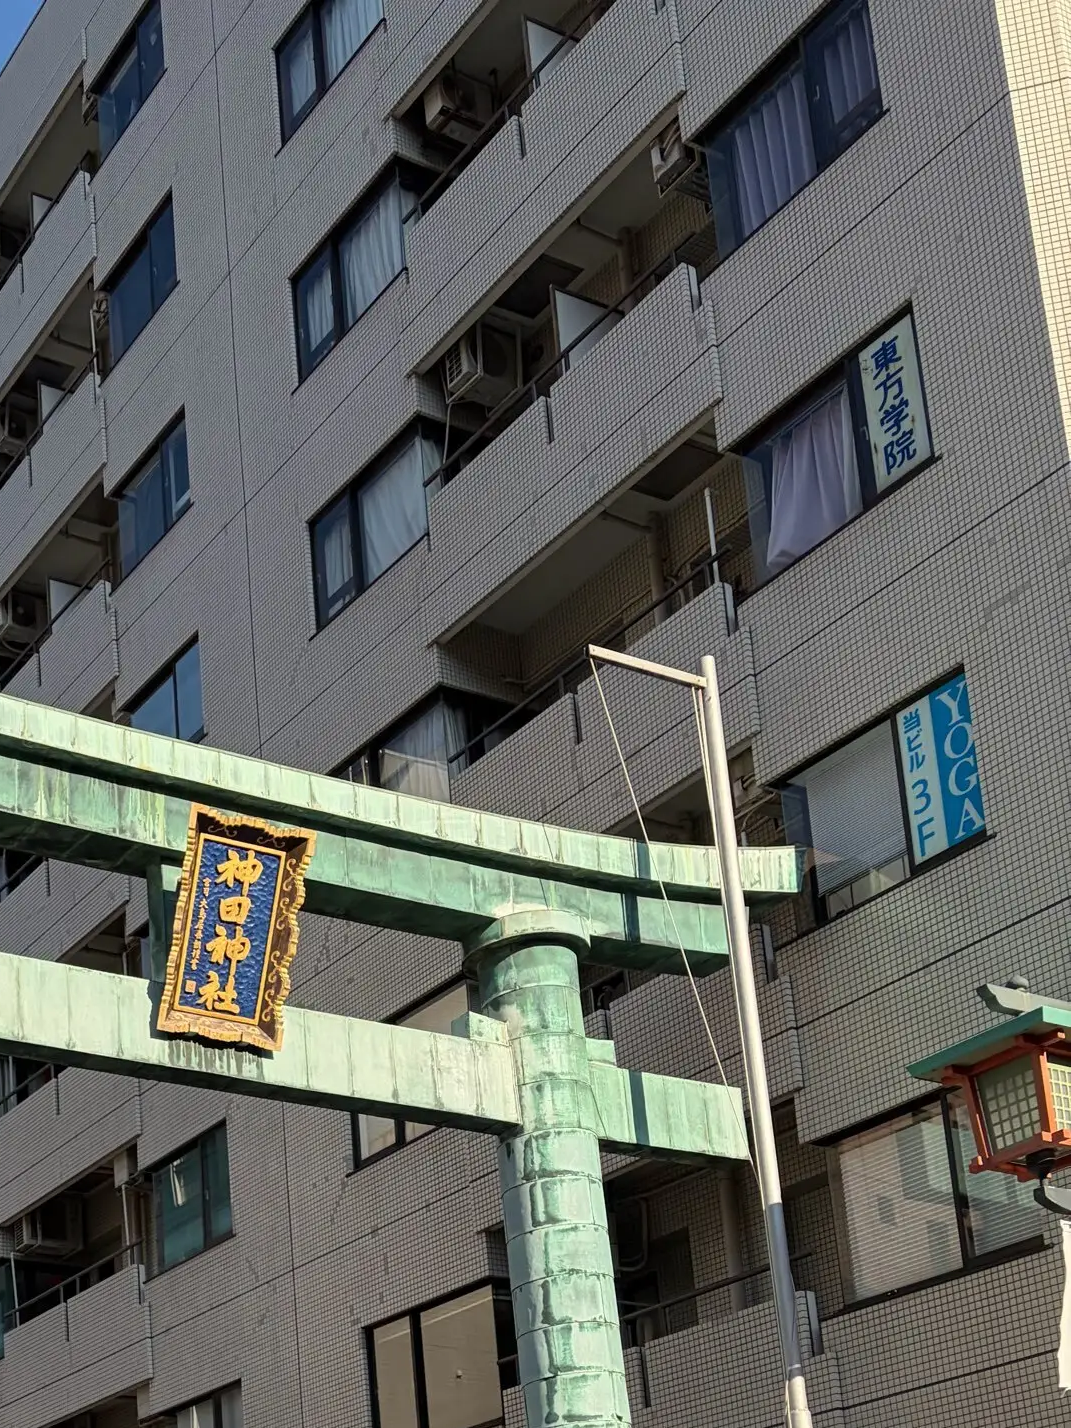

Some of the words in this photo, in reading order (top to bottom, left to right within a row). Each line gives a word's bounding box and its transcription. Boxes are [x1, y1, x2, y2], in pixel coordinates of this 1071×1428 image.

[870, 335, 917, 476] 東方学院
[935, 680, 986, 840] YOGA
[198, 849, 264, 1015] 神田神社
